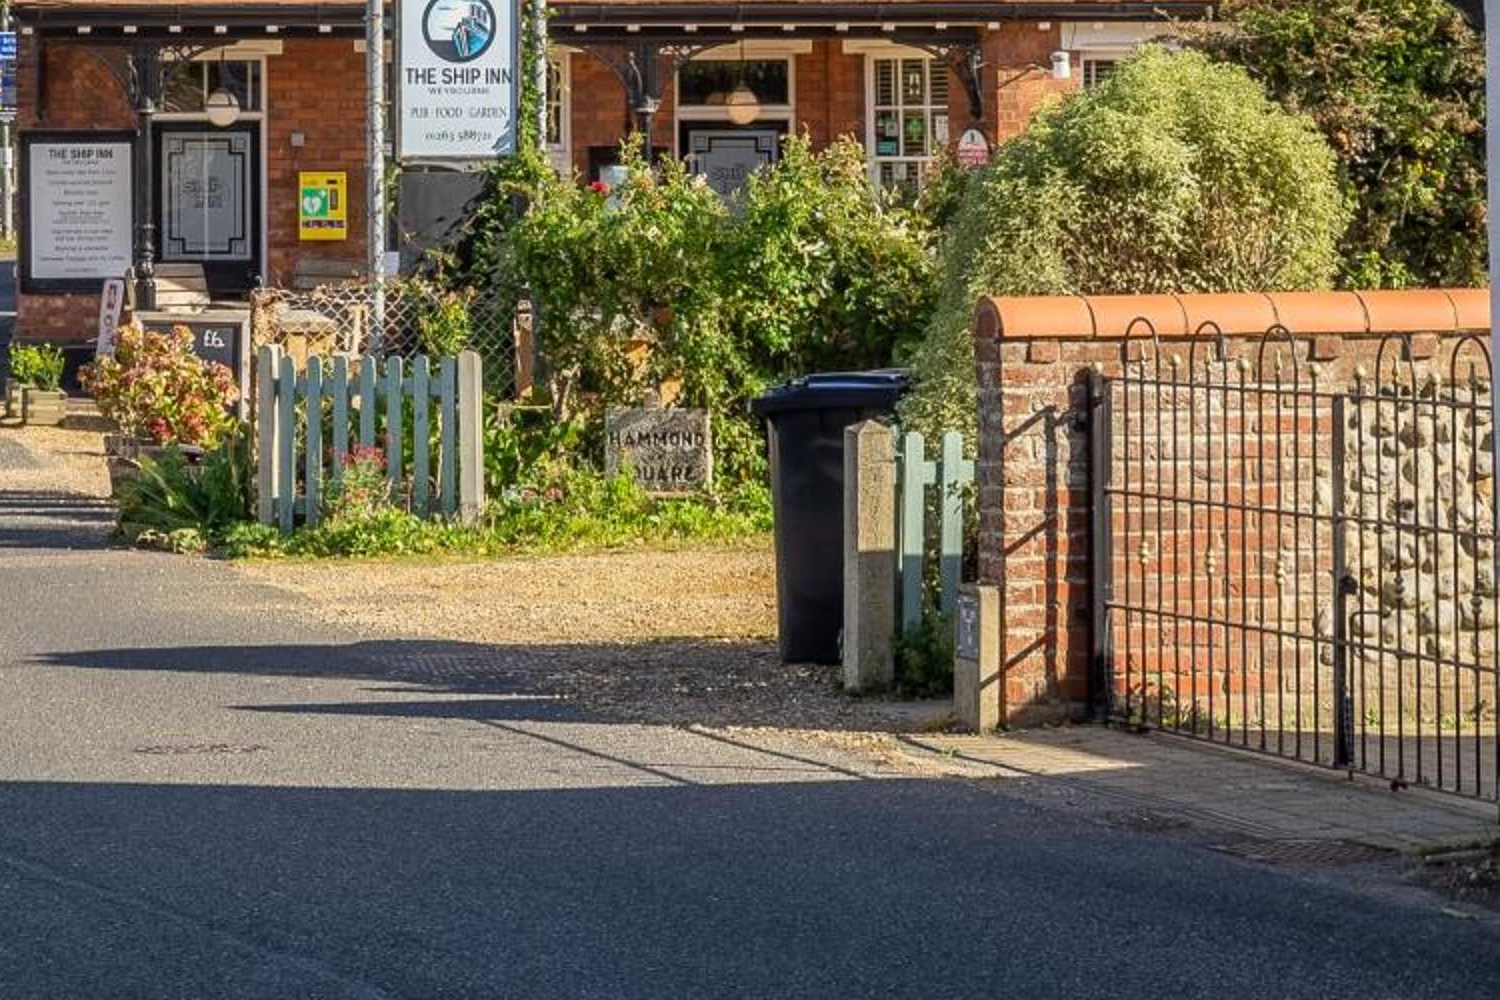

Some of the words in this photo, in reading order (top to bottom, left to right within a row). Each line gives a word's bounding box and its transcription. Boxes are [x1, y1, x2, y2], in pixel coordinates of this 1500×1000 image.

[406, 67, 436, 85] THE
[441, 67, 481, 85] SHIP
[485, 67, 512, 85] INN
[410, 107, 428, 118] PUB
[435, 107, 463, 118] FOOD
[468, 107, 507, 118] GARDEN
[48, 149, 68, 159] THE
[70, 149, 94, 159] SHIP
[96, 149, 113, 159] INN
[609, 432, 705, 447] HAMMOND
